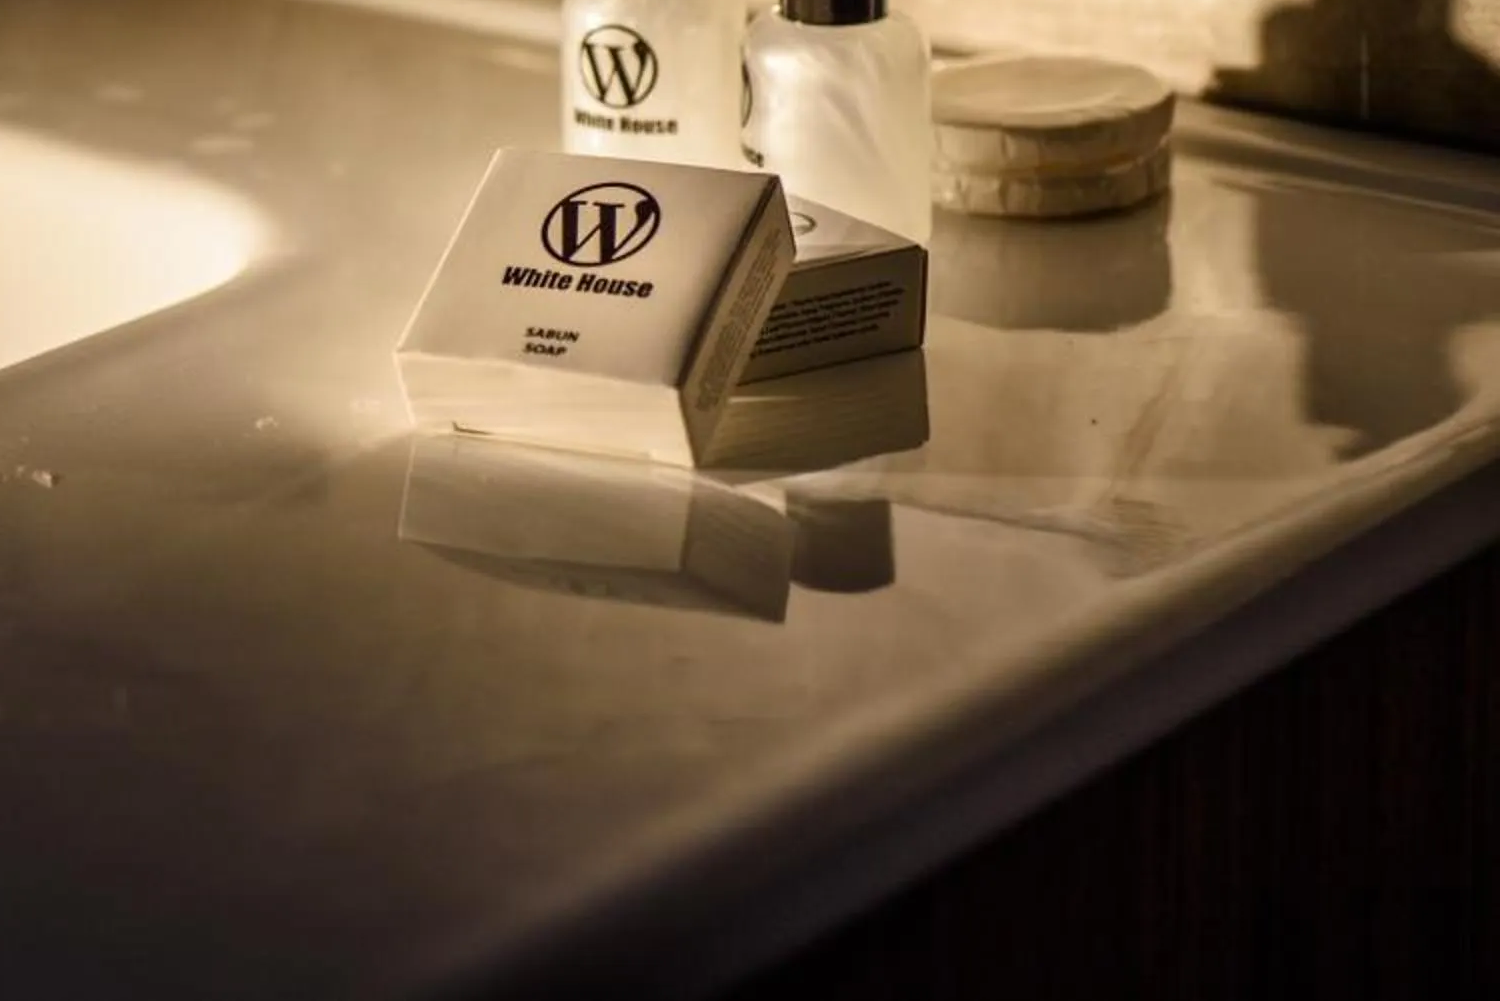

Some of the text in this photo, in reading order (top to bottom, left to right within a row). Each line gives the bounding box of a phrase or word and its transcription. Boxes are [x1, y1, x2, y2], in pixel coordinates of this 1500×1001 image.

[581, 39, 653, 106] W
[619, 116, 678, 134] House
[558, 197, 659, 262] W
[502, 266, 654, 298] White House
[524, 327, 580, 342] SABUN
[523, 342, 568, 356] SOAP
